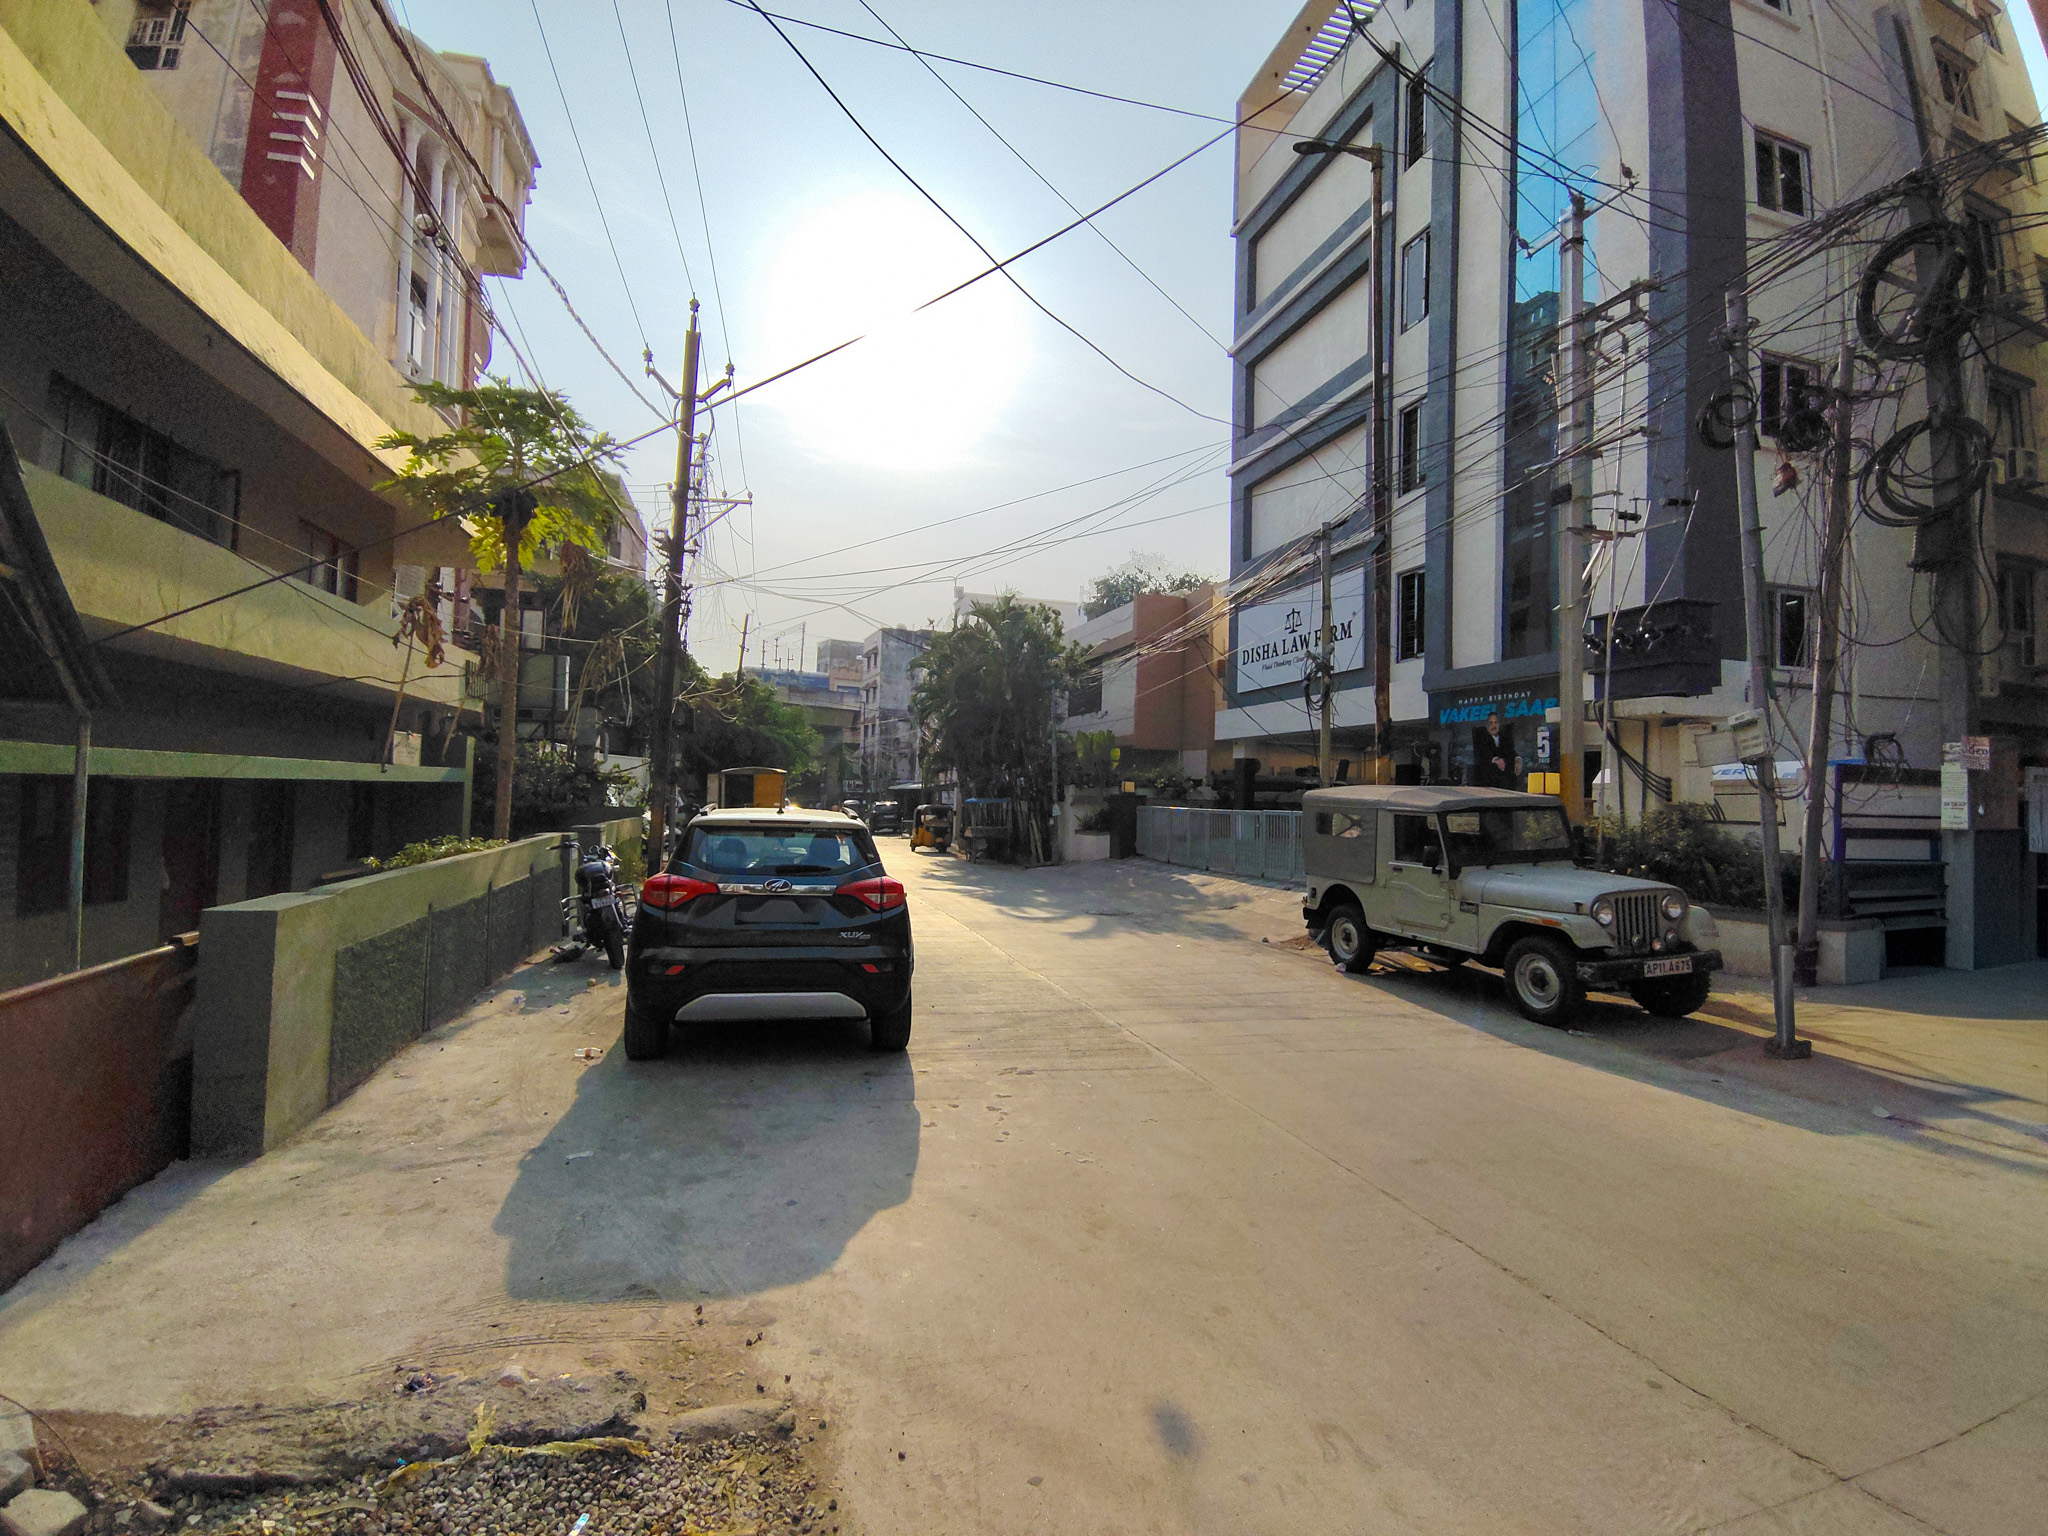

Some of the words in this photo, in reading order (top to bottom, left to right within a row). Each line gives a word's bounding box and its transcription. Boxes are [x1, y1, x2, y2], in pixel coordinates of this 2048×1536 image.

[1242, 642, 1279, 665] DISHA
[1281, 632, 1312, 656] LAW
[1314, 620, 1353, 648] FRM
[1261, 661, 1273, 672] Fluid
[1273, 658, 1292, 669] Thinking
[1458, 697, 1484, 705] HAPPY
[1488, 691, 1531, 702] BIRTHDAY
[1537, 731, 1550, 758] 5
